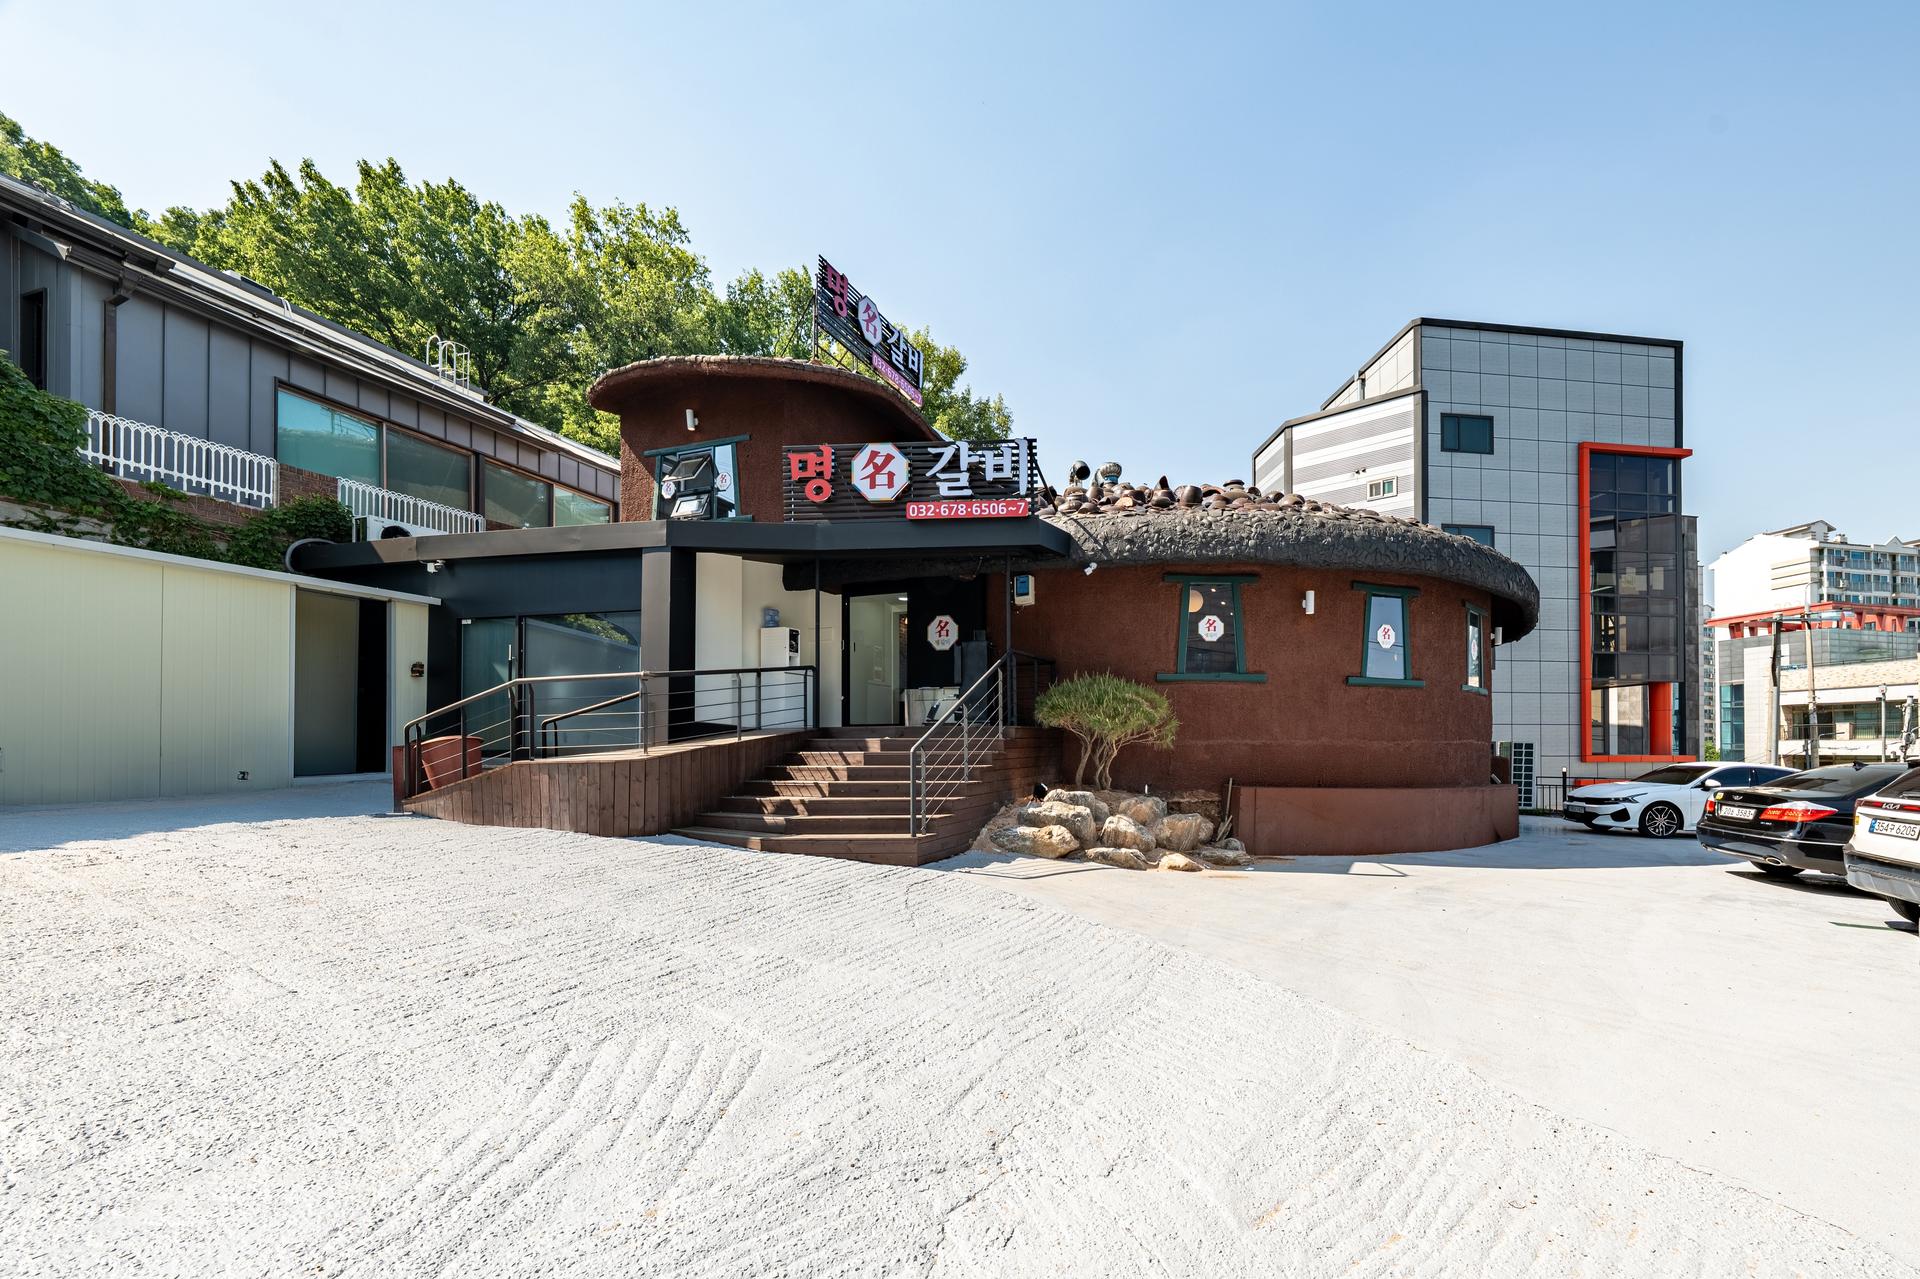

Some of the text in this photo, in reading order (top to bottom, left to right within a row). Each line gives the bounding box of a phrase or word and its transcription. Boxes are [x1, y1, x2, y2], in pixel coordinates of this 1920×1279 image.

[825, 262, 924, 389] 명 名 갈비
[787, 437, 1028, 502] 명 名 갈비
[936, 619, 950, 638] 名
[1895, 824, 1918, 837] 6205
